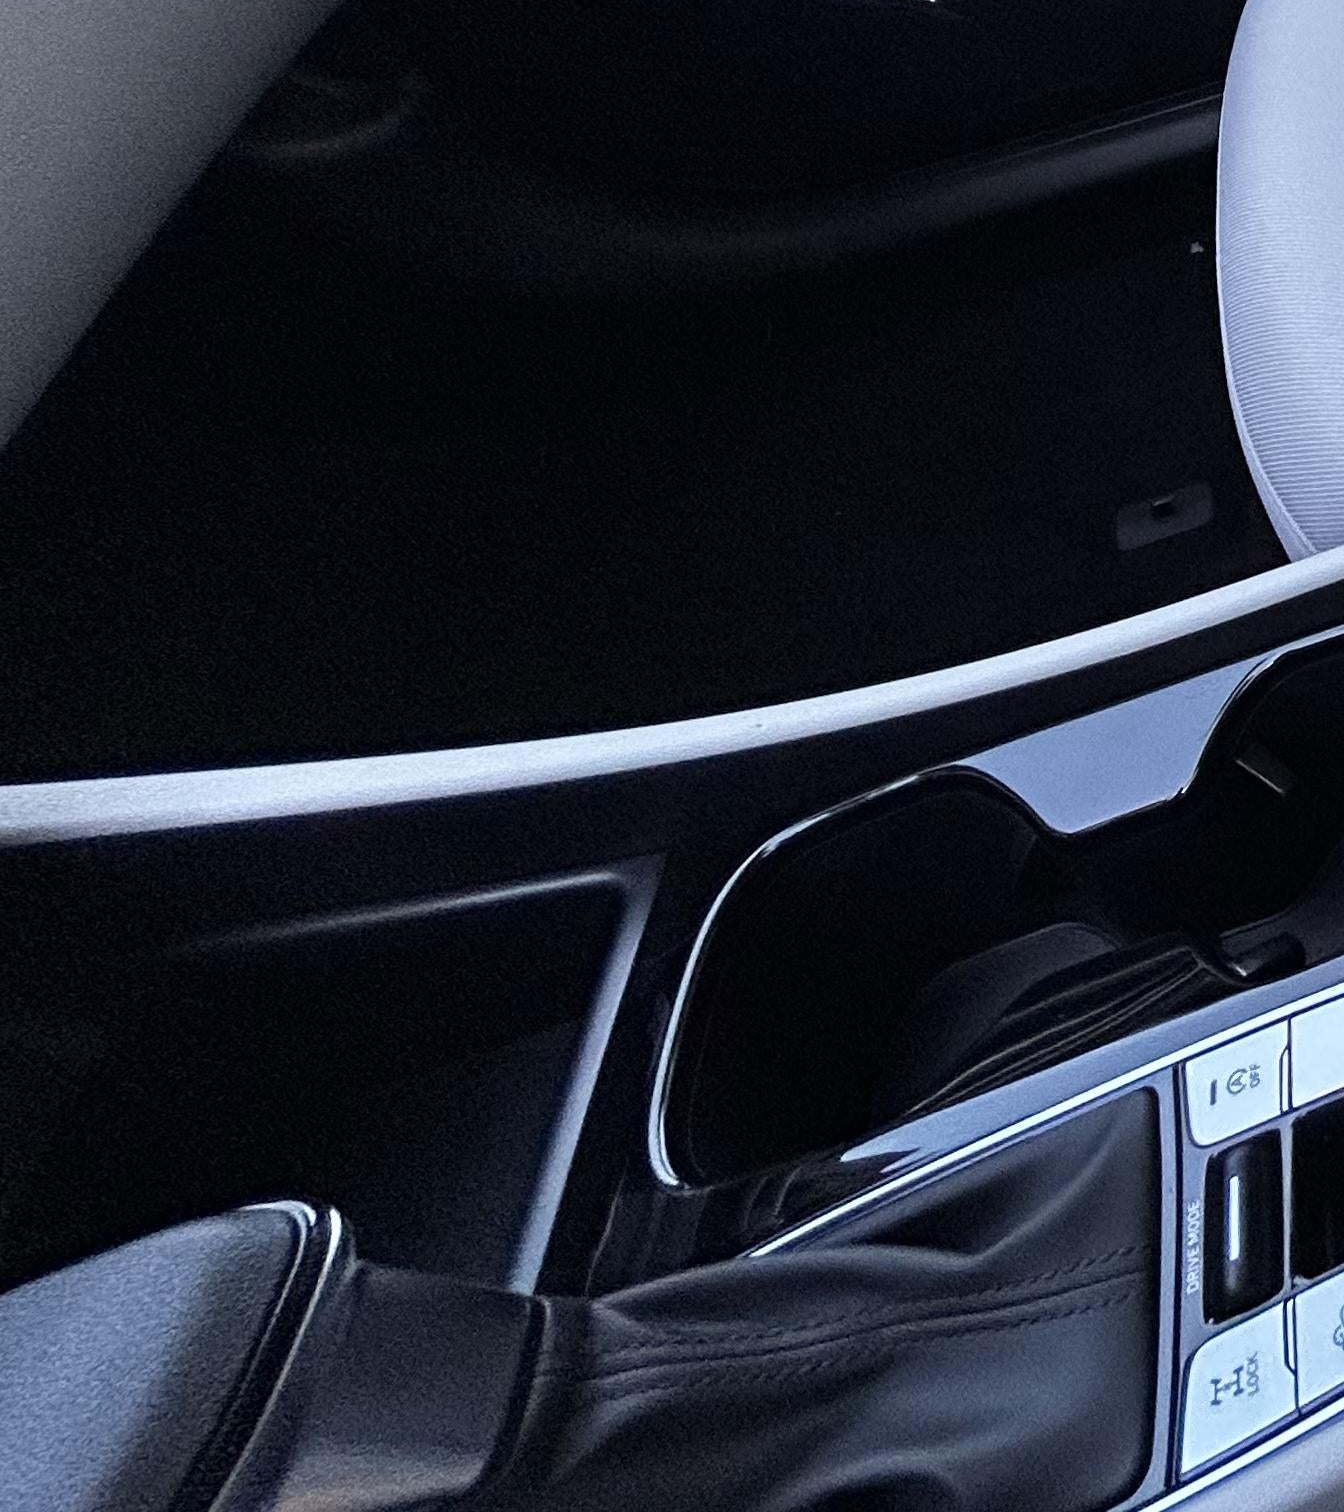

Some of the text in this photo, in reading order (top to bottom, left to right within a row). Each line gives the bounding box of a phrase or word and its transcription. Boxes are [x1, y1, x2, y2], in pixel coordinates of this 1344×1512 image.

[1186, 1199, 1201, 1296] DRIVE MODE
[1246, 1351, 1260, 1397] LOCK
